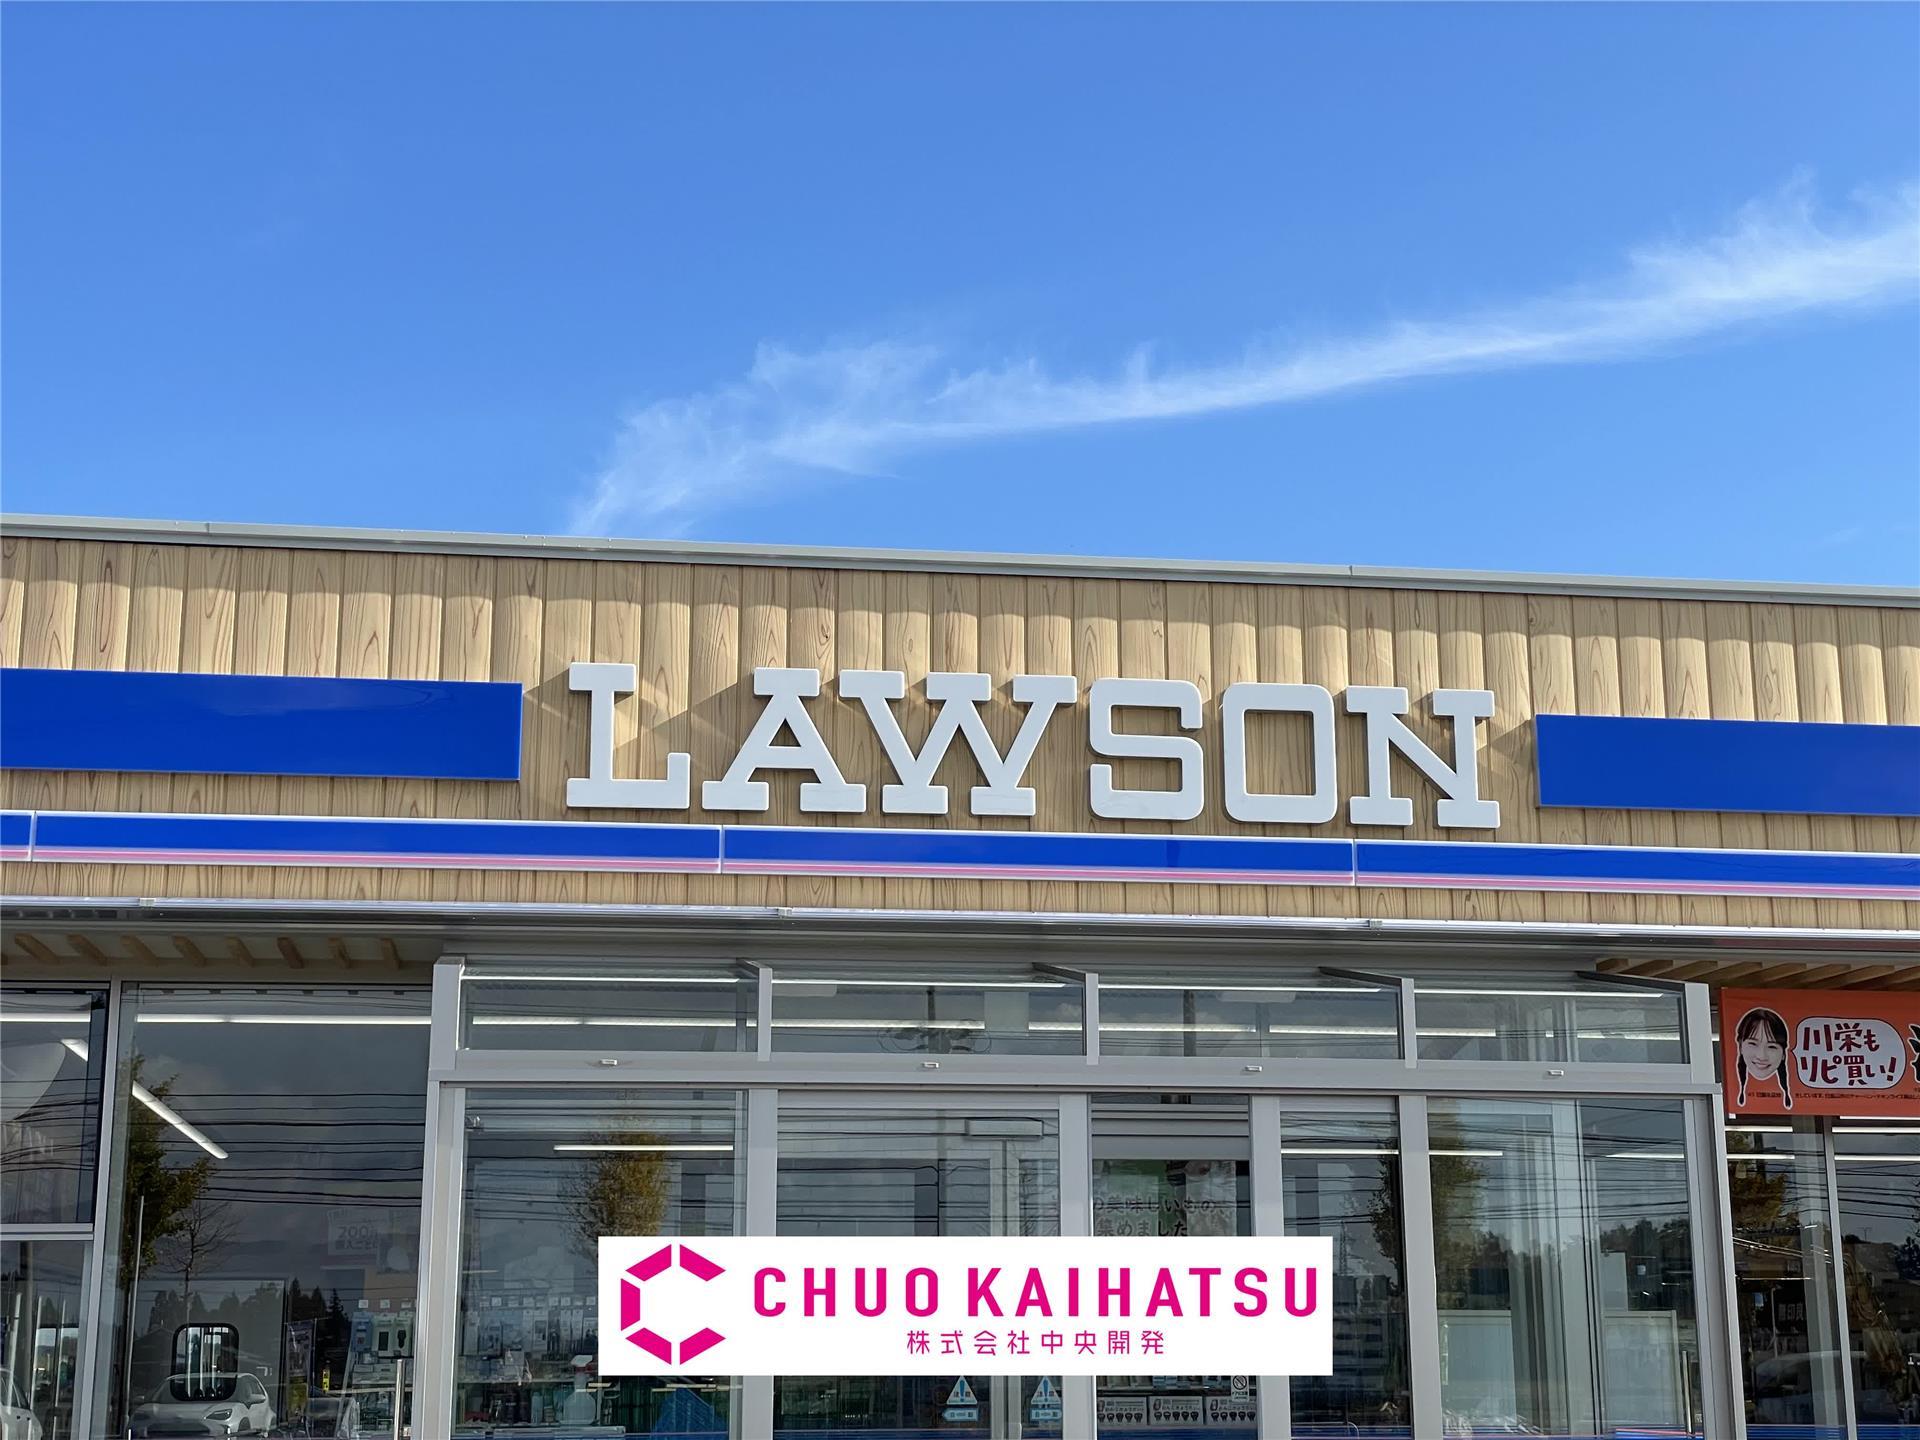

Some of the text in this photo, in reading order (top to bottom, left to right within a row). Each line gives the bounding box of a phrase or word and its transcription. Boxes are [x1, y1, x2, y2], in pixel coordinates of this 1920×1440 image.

[566, 662, 1500, 829] LAWSON
[1803, 1022, 1880, 1052] 川栄も
